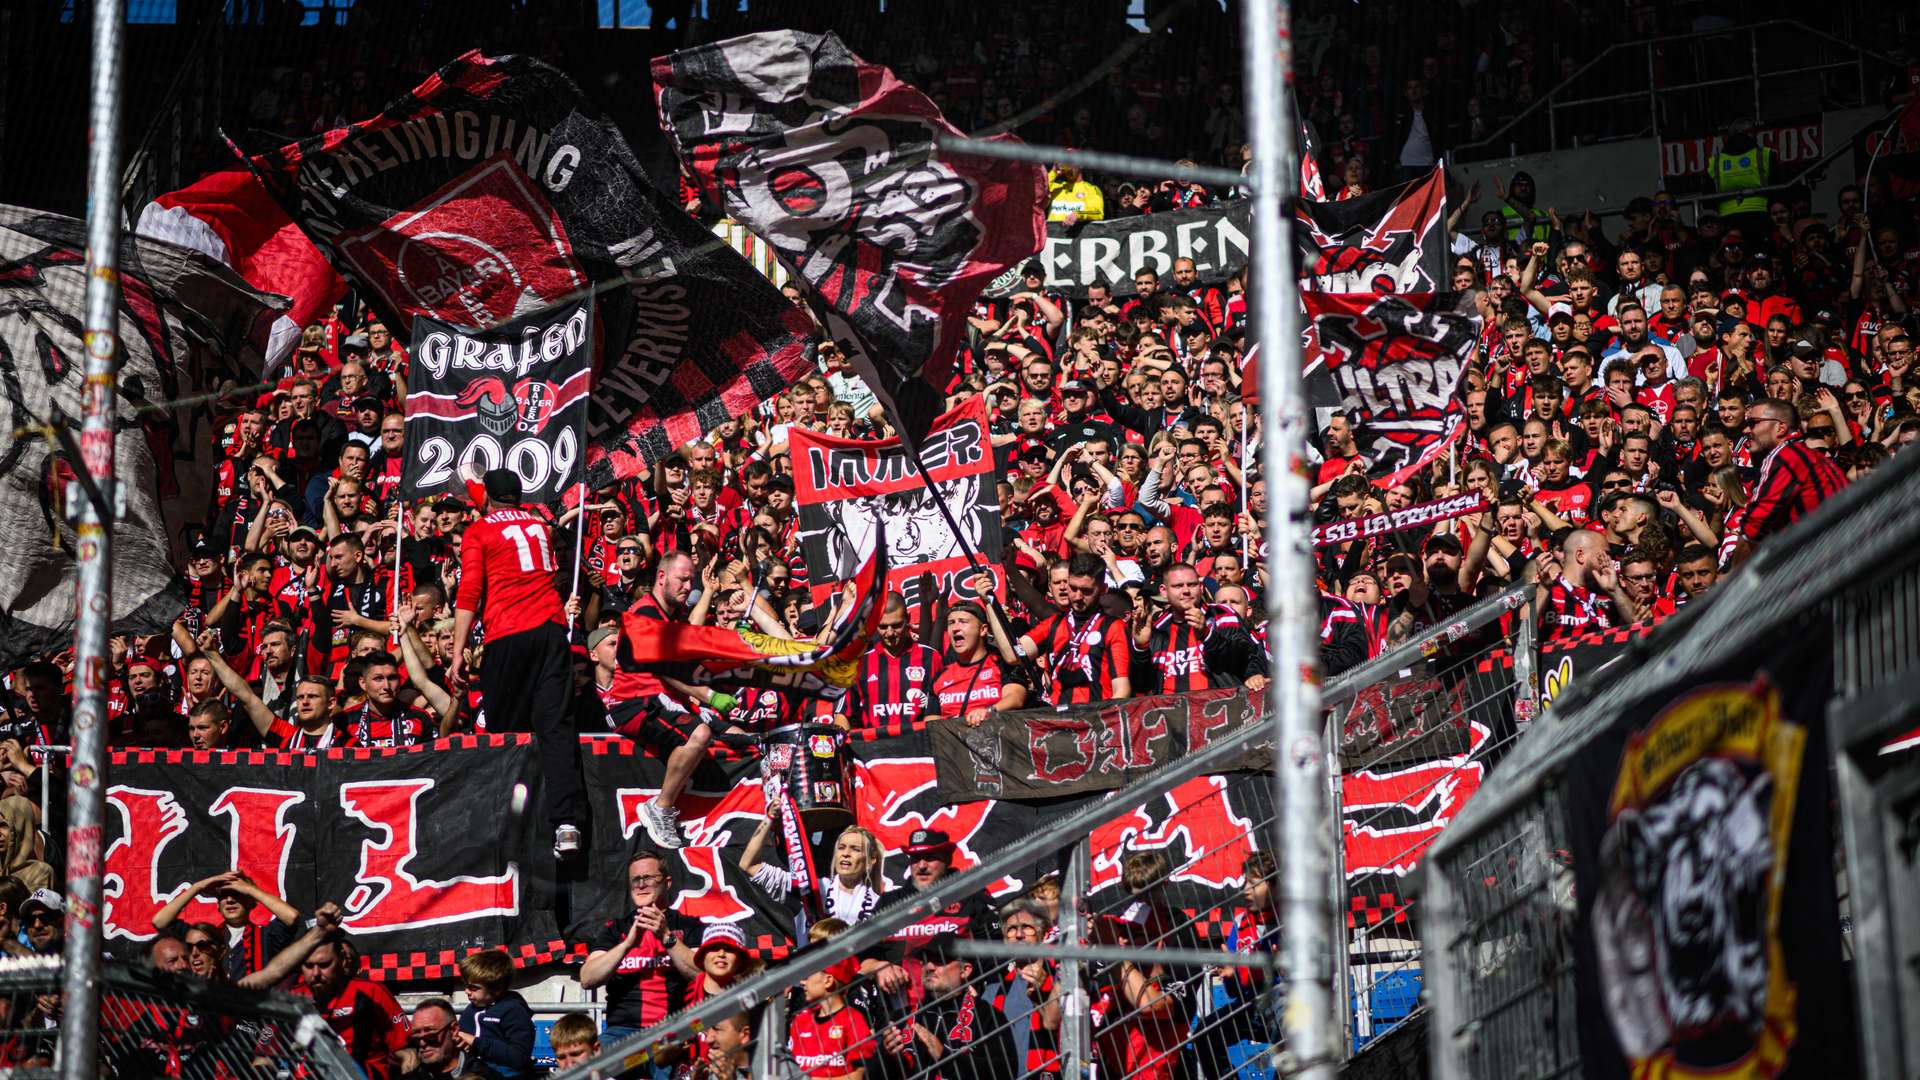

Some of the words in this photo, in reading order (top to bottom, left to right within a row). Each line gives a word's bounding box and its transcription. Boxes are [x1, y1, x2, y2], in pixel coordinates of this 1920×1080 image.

[515, 395, 552, 407] BAYER
[527, 385, 541, 420] BAYER
[518, 422, 539, 434] 04
[416, 425, 578, 493] 2009
[1324, 521, 1357, 546] 513
[502, 524, 551, 572] 11
[873, 702, 916, 717] RWE
[794, 1052, 847, 1067] armenia
